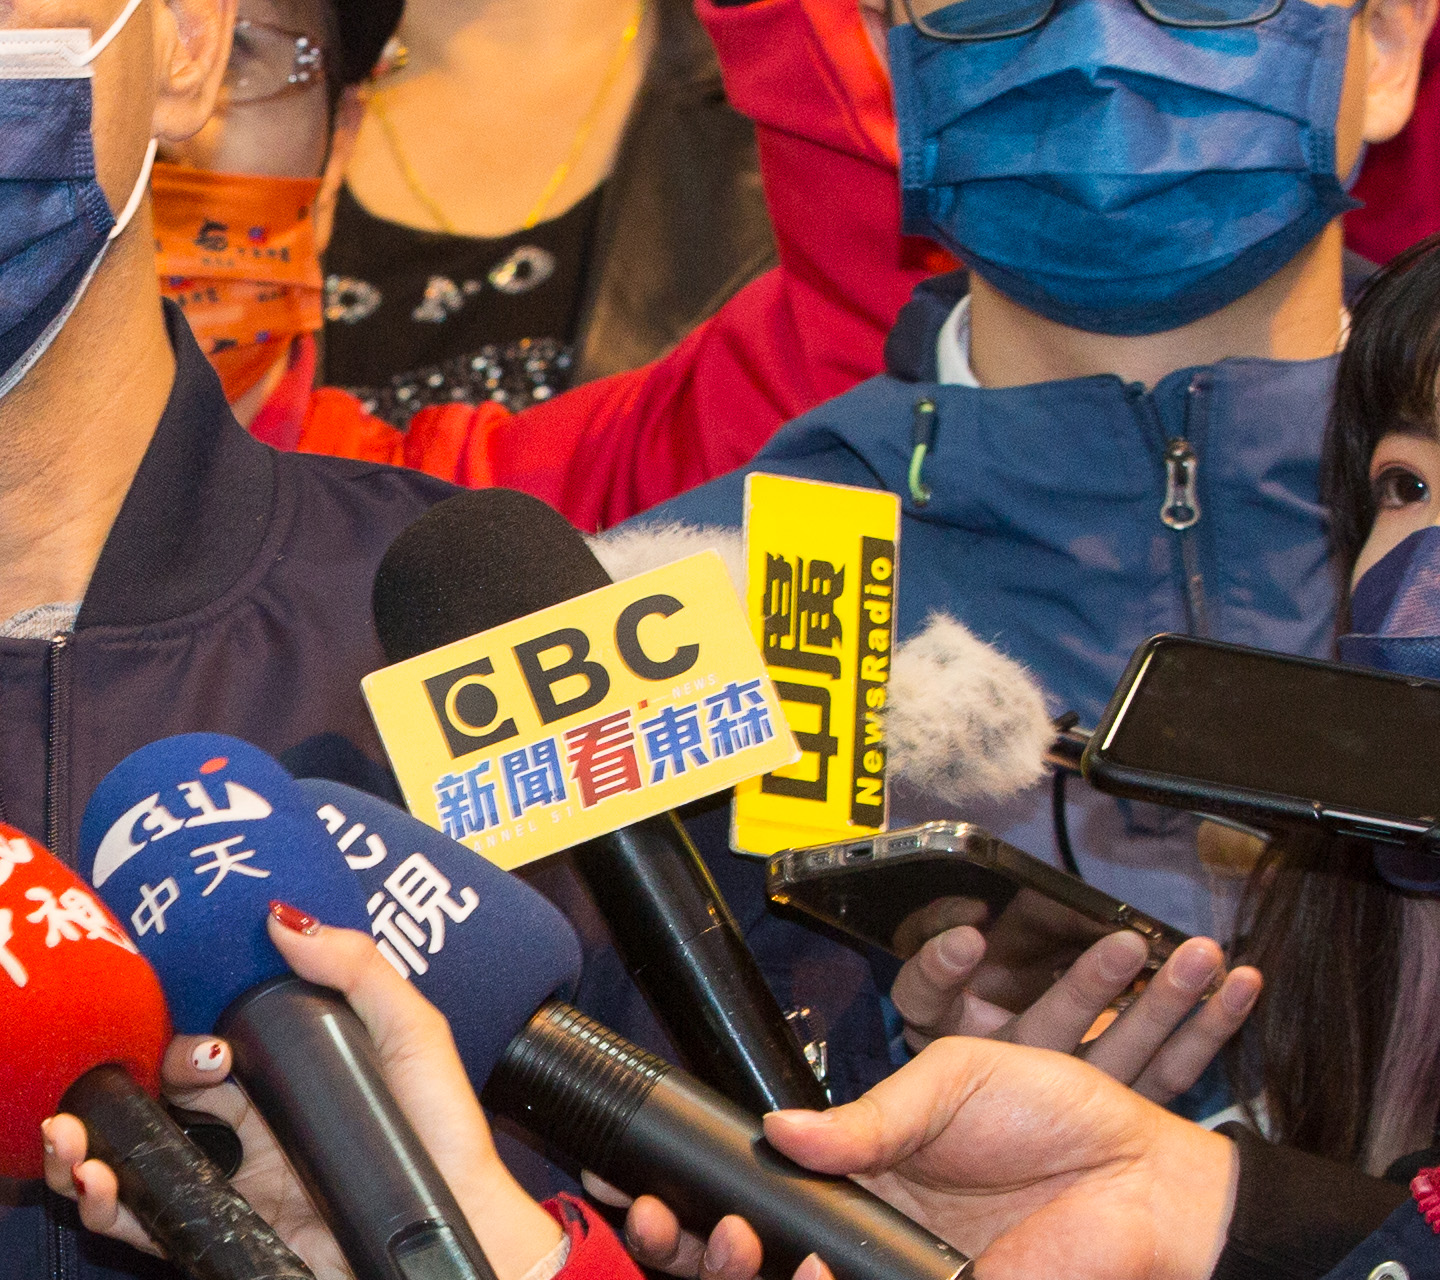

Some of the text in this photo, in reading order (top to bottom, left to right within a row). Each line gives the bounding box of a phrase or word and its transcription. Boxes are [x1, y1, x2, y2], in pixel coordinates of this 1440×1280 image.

[422, 593, 700, 760] EBC
[672, 673, 717, 700] NEWS
[760, 550, 846, 803] 中廣
[855, 556, 894, 807] NewsRadio
[433, 677, 776, 842] 新聞看東森
[474, 820, 538, 852] ANNEL
[130, 834, 271, 937] 中天
